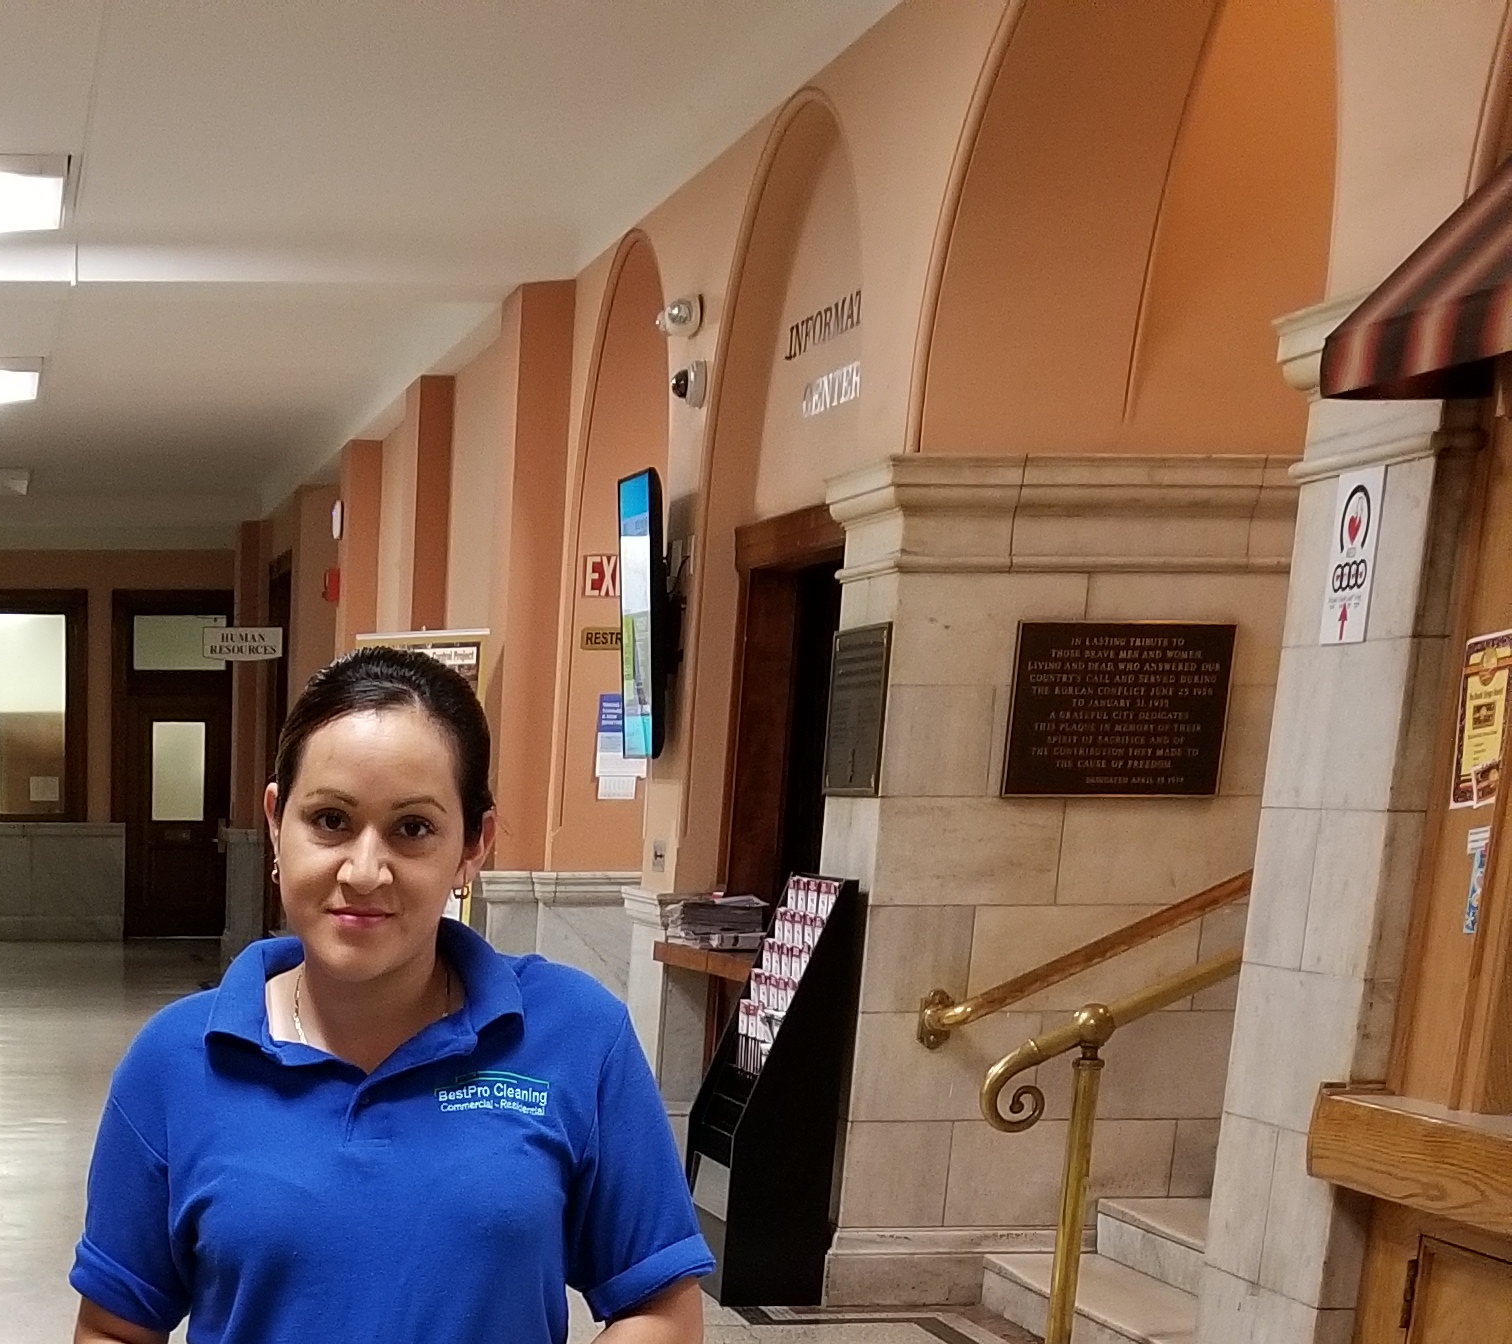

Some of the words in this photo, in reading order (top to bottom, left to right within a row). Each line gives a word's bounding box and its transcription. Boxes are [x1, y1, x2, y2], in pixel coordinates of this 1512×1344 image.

[221, 632, 265, 642] HUMAN
[210, 645, 277, 654] RESOURCES
[438, 1085, 490, 1102] BestPro
[494, 1083, 548, 1106] Cleaning
[440, 1099, 493, 1112] Commercial
